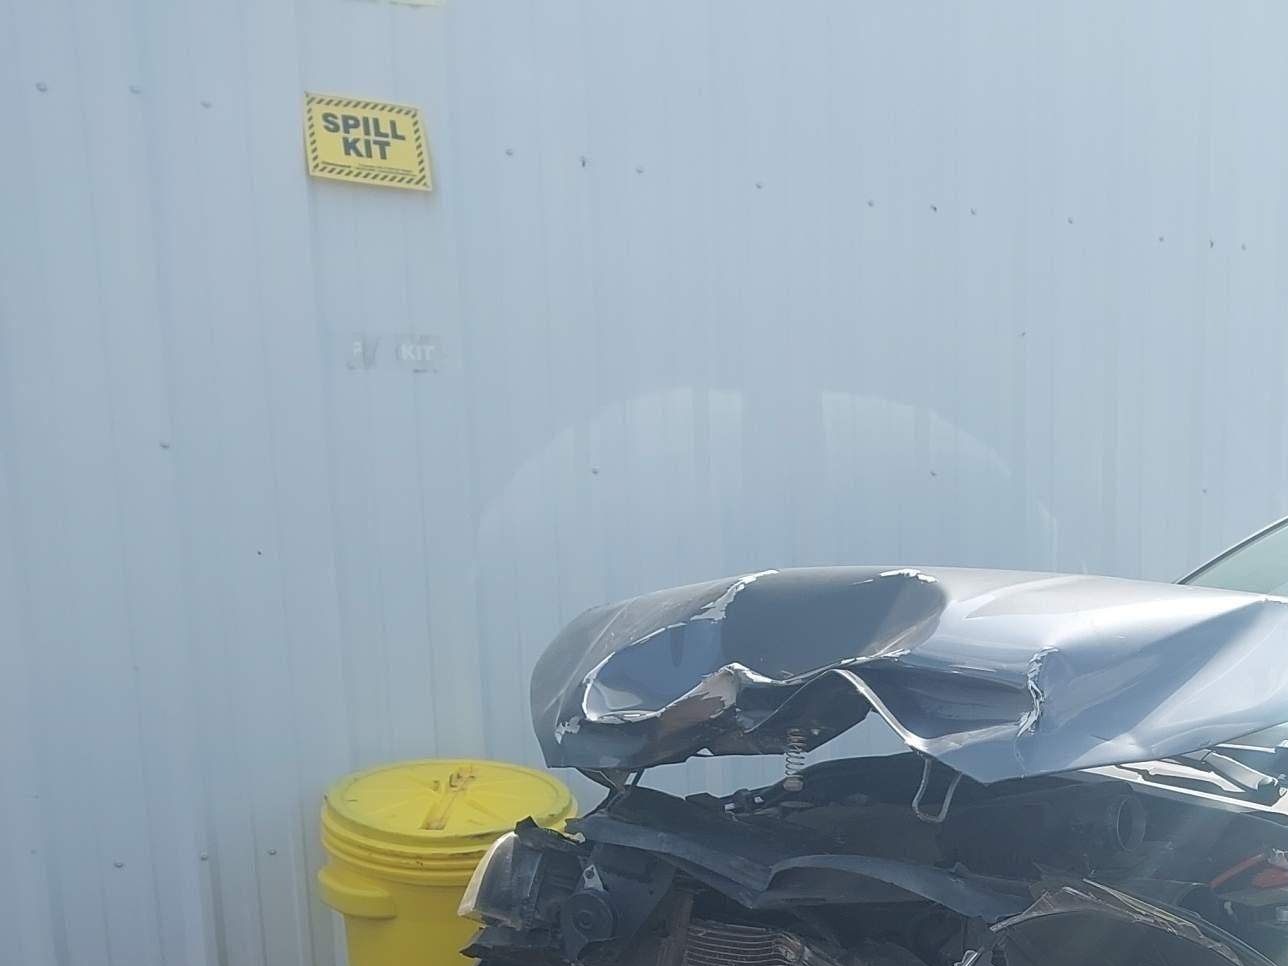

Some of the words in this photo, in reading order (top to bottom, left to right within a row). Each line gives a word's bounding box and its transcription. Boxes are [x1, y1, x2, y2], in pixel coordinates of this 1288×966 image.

[321, 112, 406, 141] SPILL
[342, 136, 391, 160] KIT
[400, 343, 435, 361] KIT
